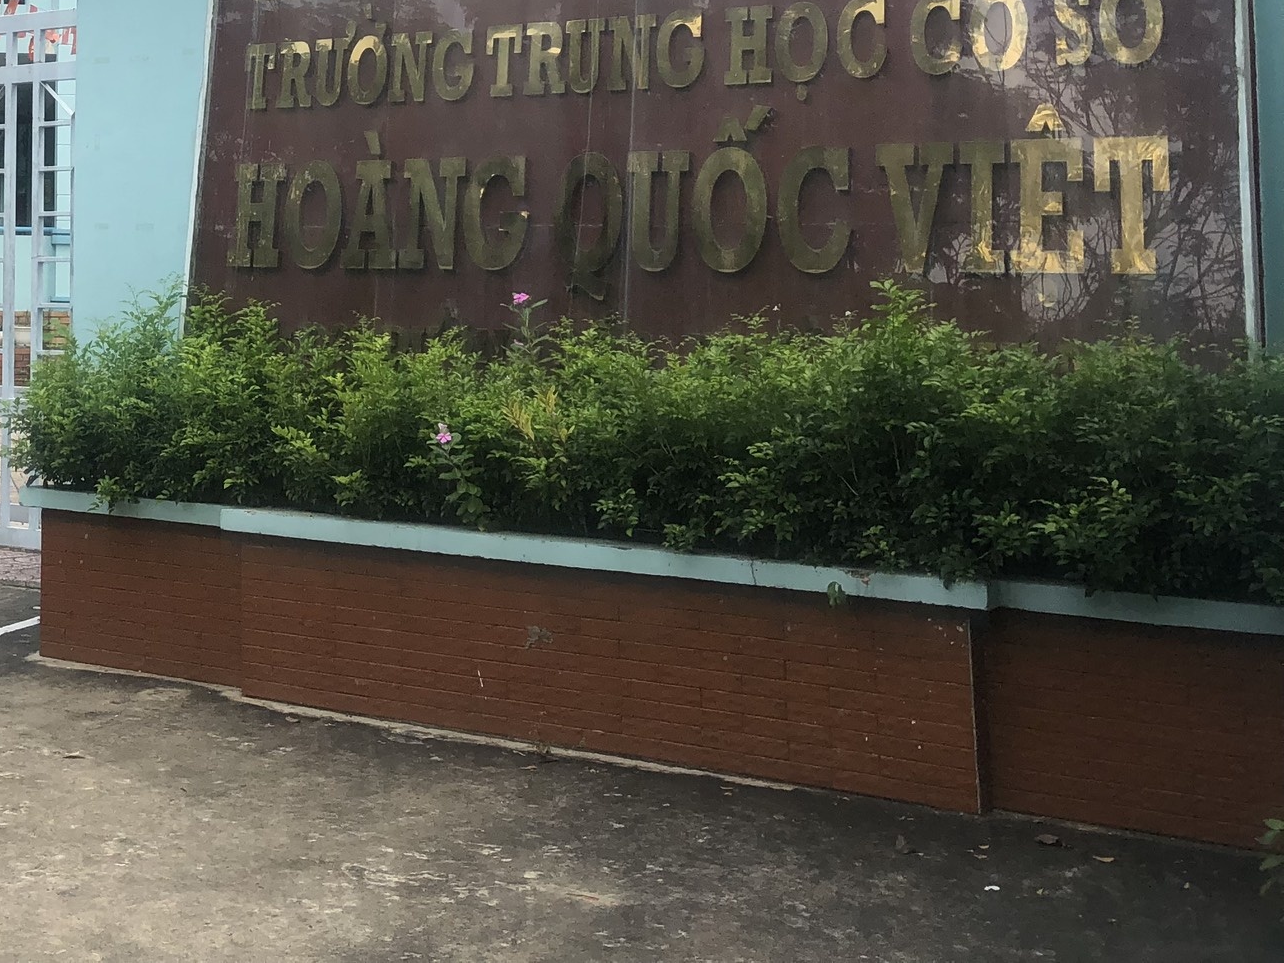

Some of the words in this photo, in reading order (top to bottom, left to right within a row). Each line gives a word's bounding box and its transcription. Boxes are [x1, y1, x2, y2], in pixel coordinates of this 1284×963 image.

[244, 3, 475, 110] TRƯỜNG
[486, 11, 705, 98] TRUNG
[226, 130, 531, 271] HOÀNG
[554, 104, 853, 301] QUỐC
